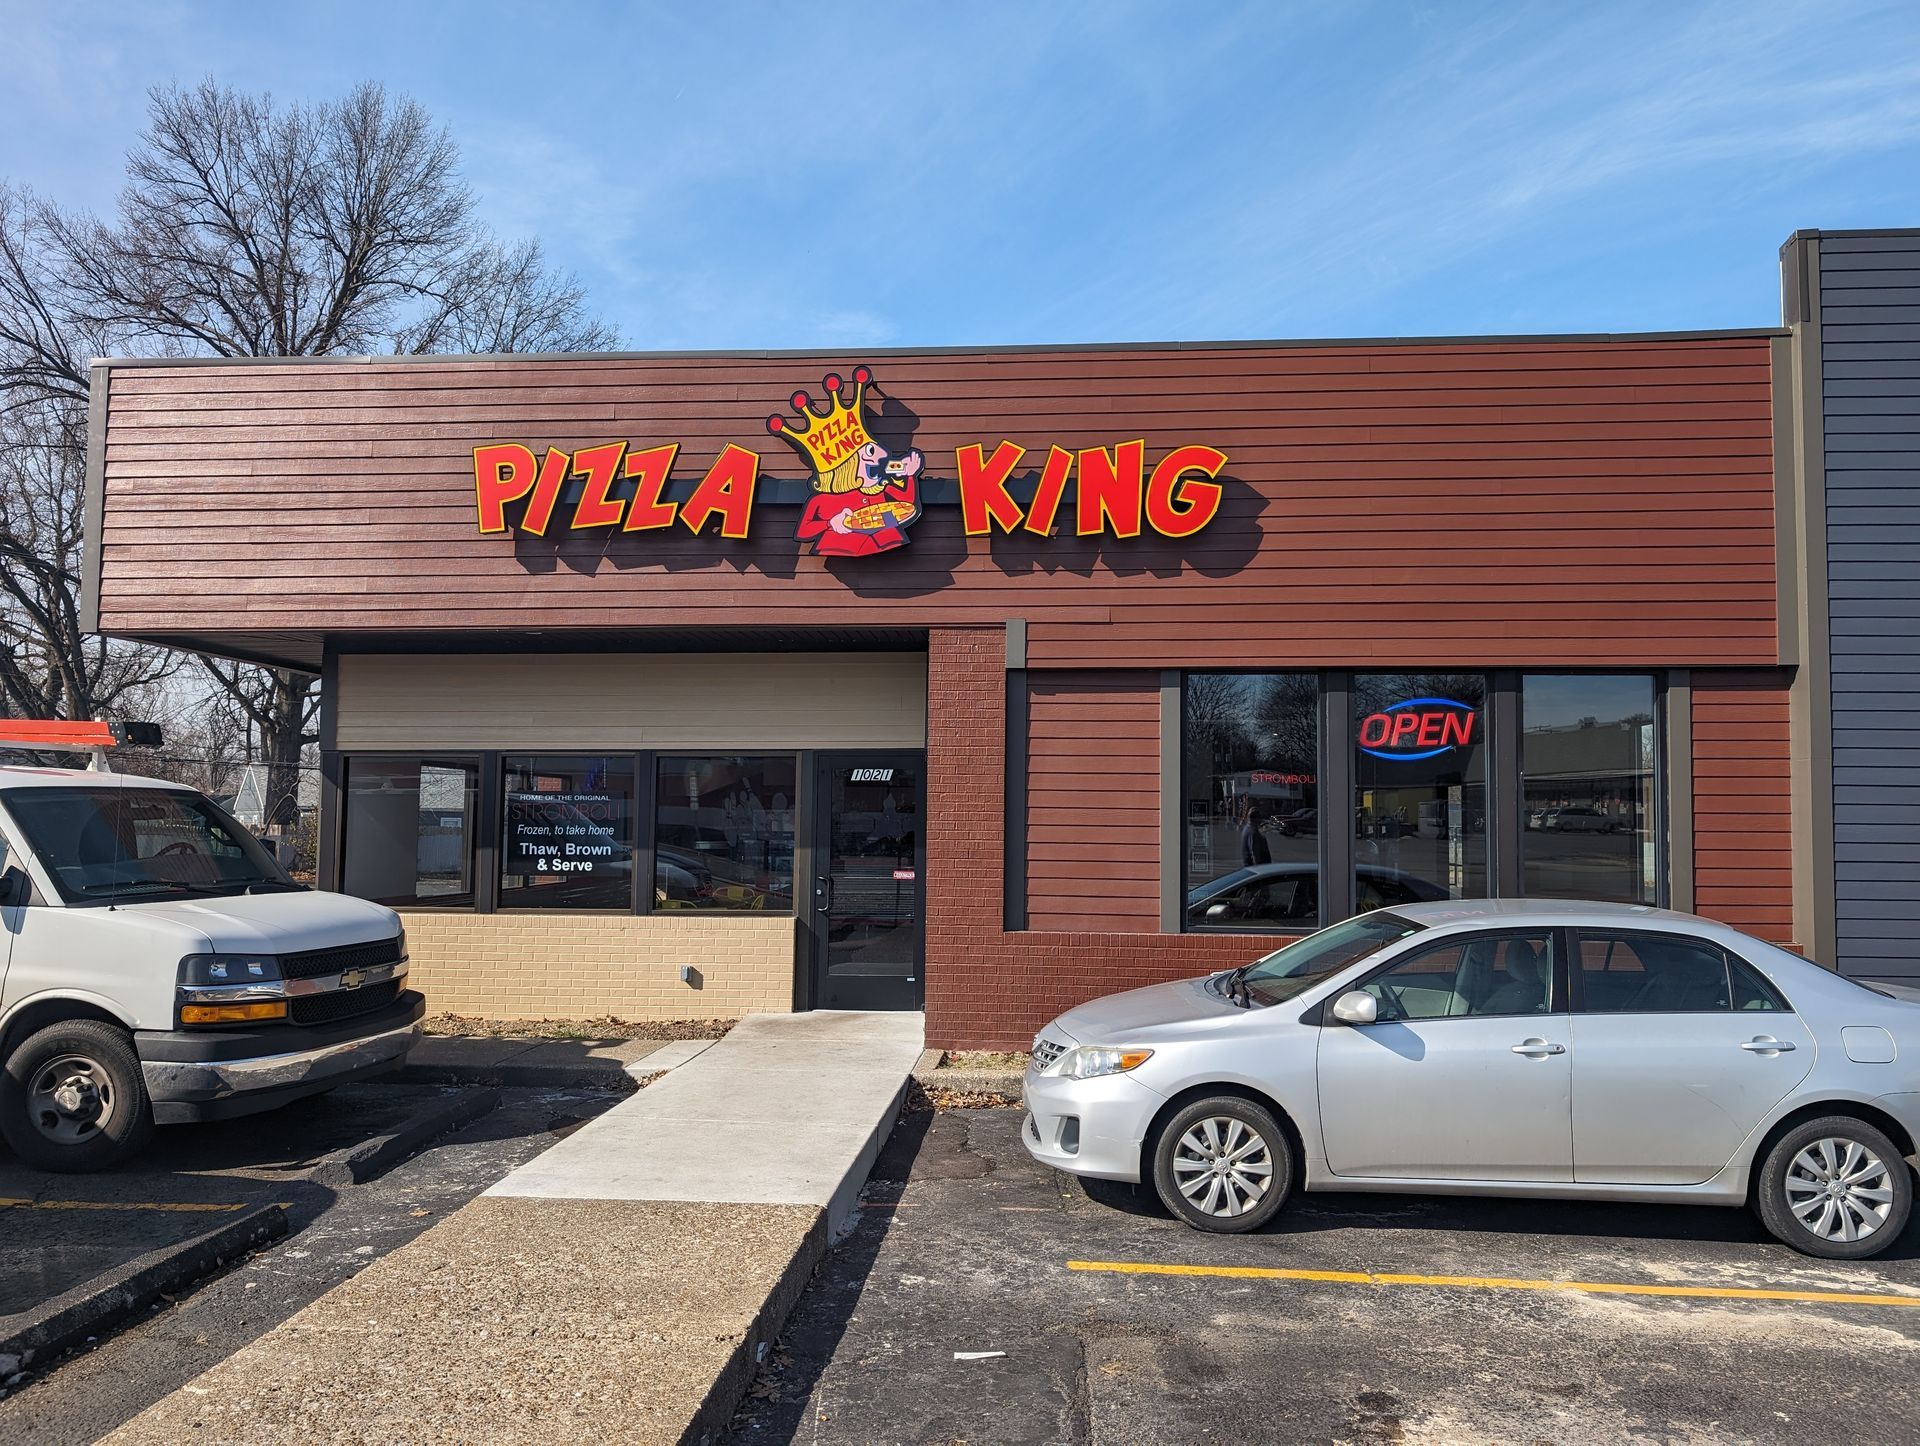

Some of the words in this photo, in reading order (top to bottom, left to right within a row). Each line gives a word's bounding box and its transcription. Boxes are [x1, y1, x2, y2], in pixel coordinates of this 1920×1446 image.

[807, 411, 859, 451] PIZZA
[820, 427, 865, 466] KING
[473, 440, 760, 538] PIZZA
[956, 438, 1229, 538] KING
[1360, 711, 1475, 747] OPEN
[853, 769, 891, 780] 1021
[1251, 773, 1317, 784] STROMBOLI
[511, 802, 620, 821] STROMBOLI
[517, 824, 551, 837] Frozen,
[554, 825, 564, 835] to
[565, 824, 586, 836] take
[588, 824, 615, 836] home
[519, 842, 561, 857] Thaw,
[565, 843, 612, 856] Brown
[537, 858, 548, 871] &
[552, 858, 593, 871] Serve
